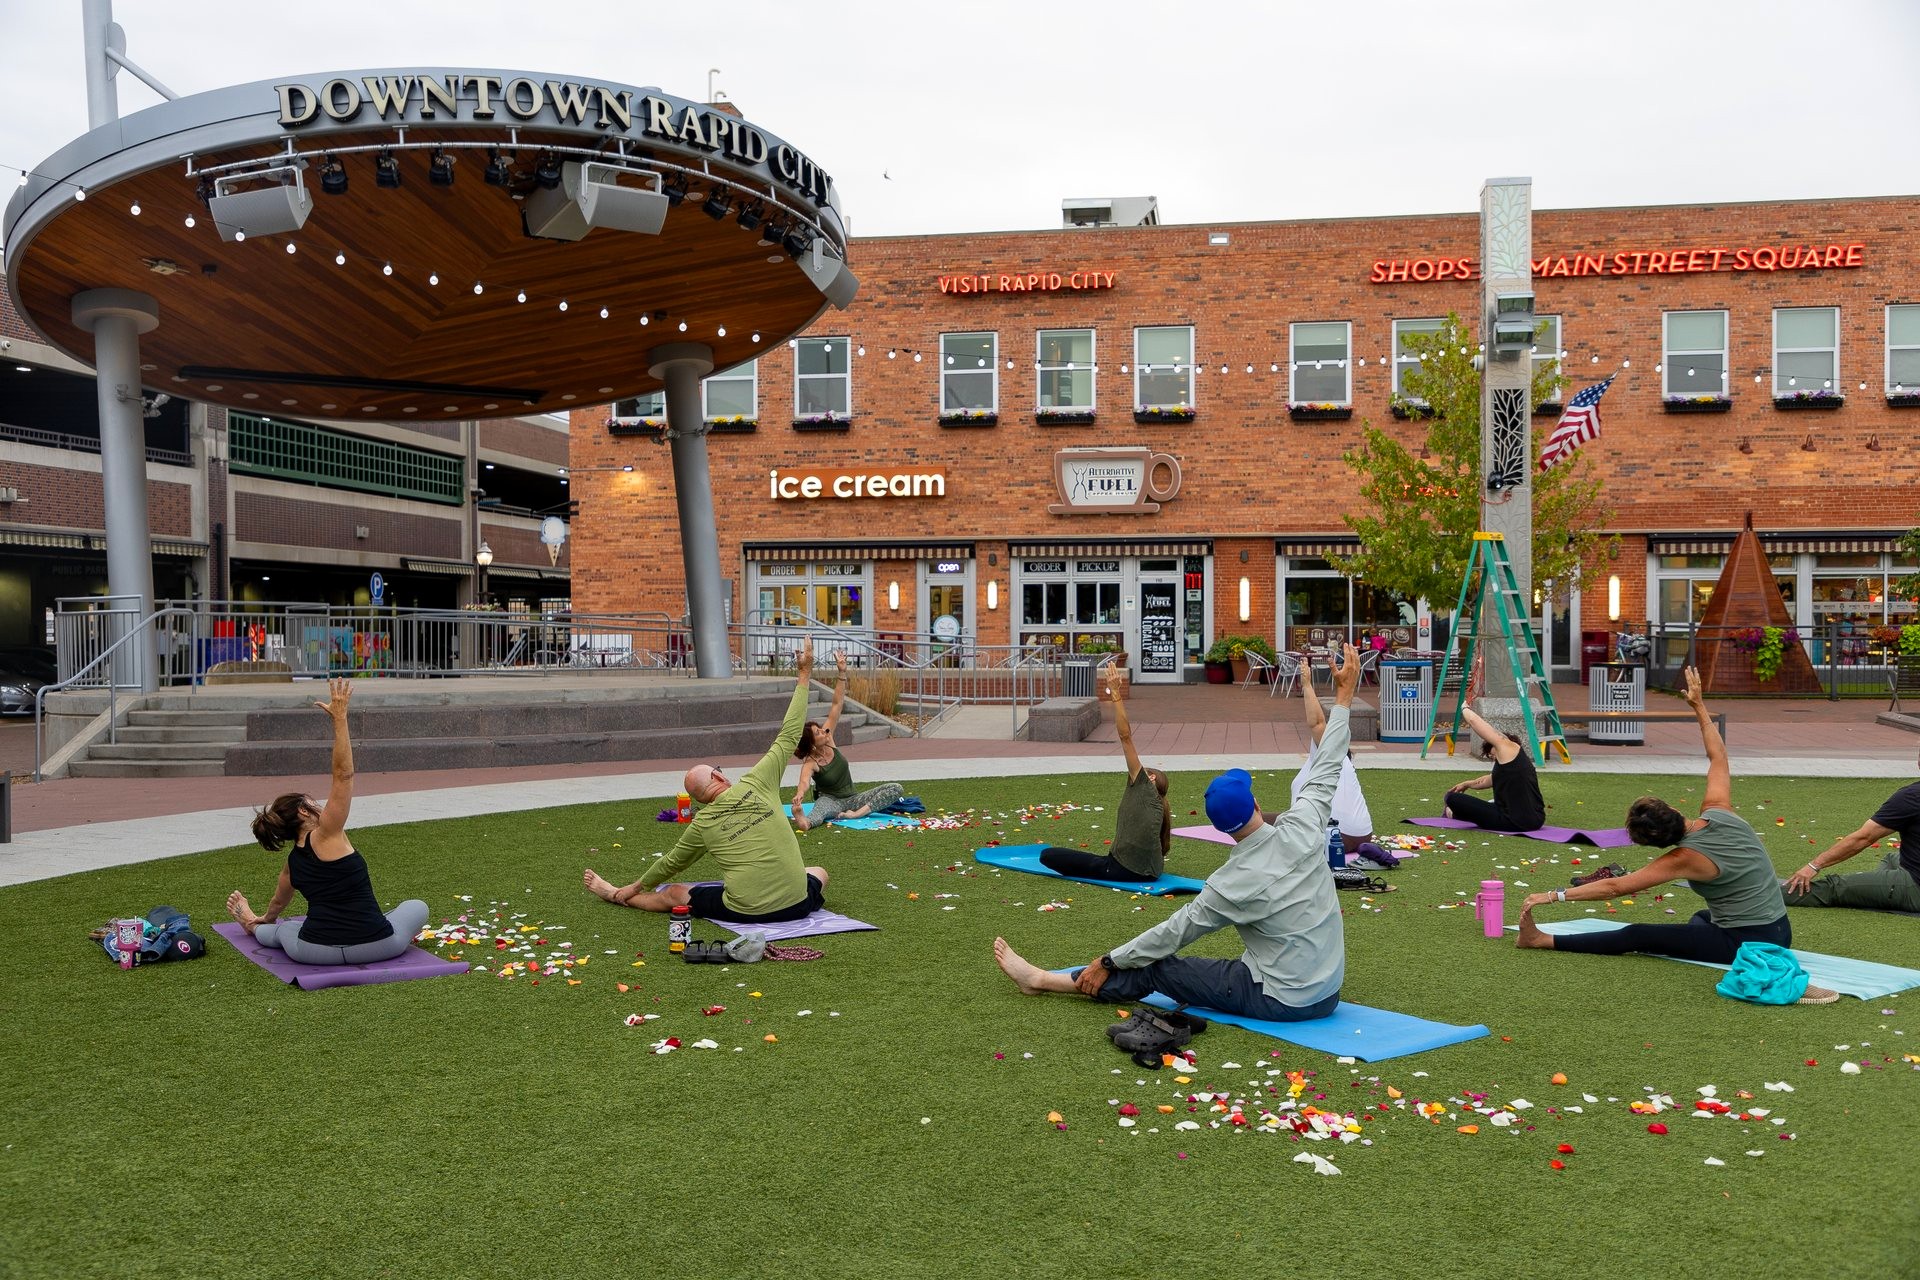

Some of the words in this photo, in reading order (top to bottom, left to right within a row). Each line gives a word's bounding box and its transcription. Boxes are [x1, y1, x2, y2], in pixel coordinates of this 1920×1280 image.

[274, 74, 633, 131] DOWNTOWN
[641, 95, 769, 166] RAPID
[769, 144, 833, 207] CITY
[1370, 257, 1474, 284] SHOPS
[1531, 252, 1607, 279] MAIN
[1611, 246, 1730, 276] STREET
[1733, 242, 1866, 272] SQUARE
[938, 275, 992, 294] VISIT
[999, 272, 1062, 293] RAPID
[1070, 270, 1116, 290] CITY
[769, 469, 823, 499] ice
[832, 473, 945, 498] cream
[1088, 479, 1137, 491] FUEL
[770, 565, 796, 576] ORDER
[823, 565, 841, 575] PICK
[843, 565, 855, 575] UP
[937, 563, 960, 573] open
[1029, 562, 1061, 572] ORDER
[1081, 562, 1102, 571] PICK
[1103, 562, 1115, 571] UP
[374, 576, 381, 595] P
[1142, 620, 1152, 651] LOCALLY
